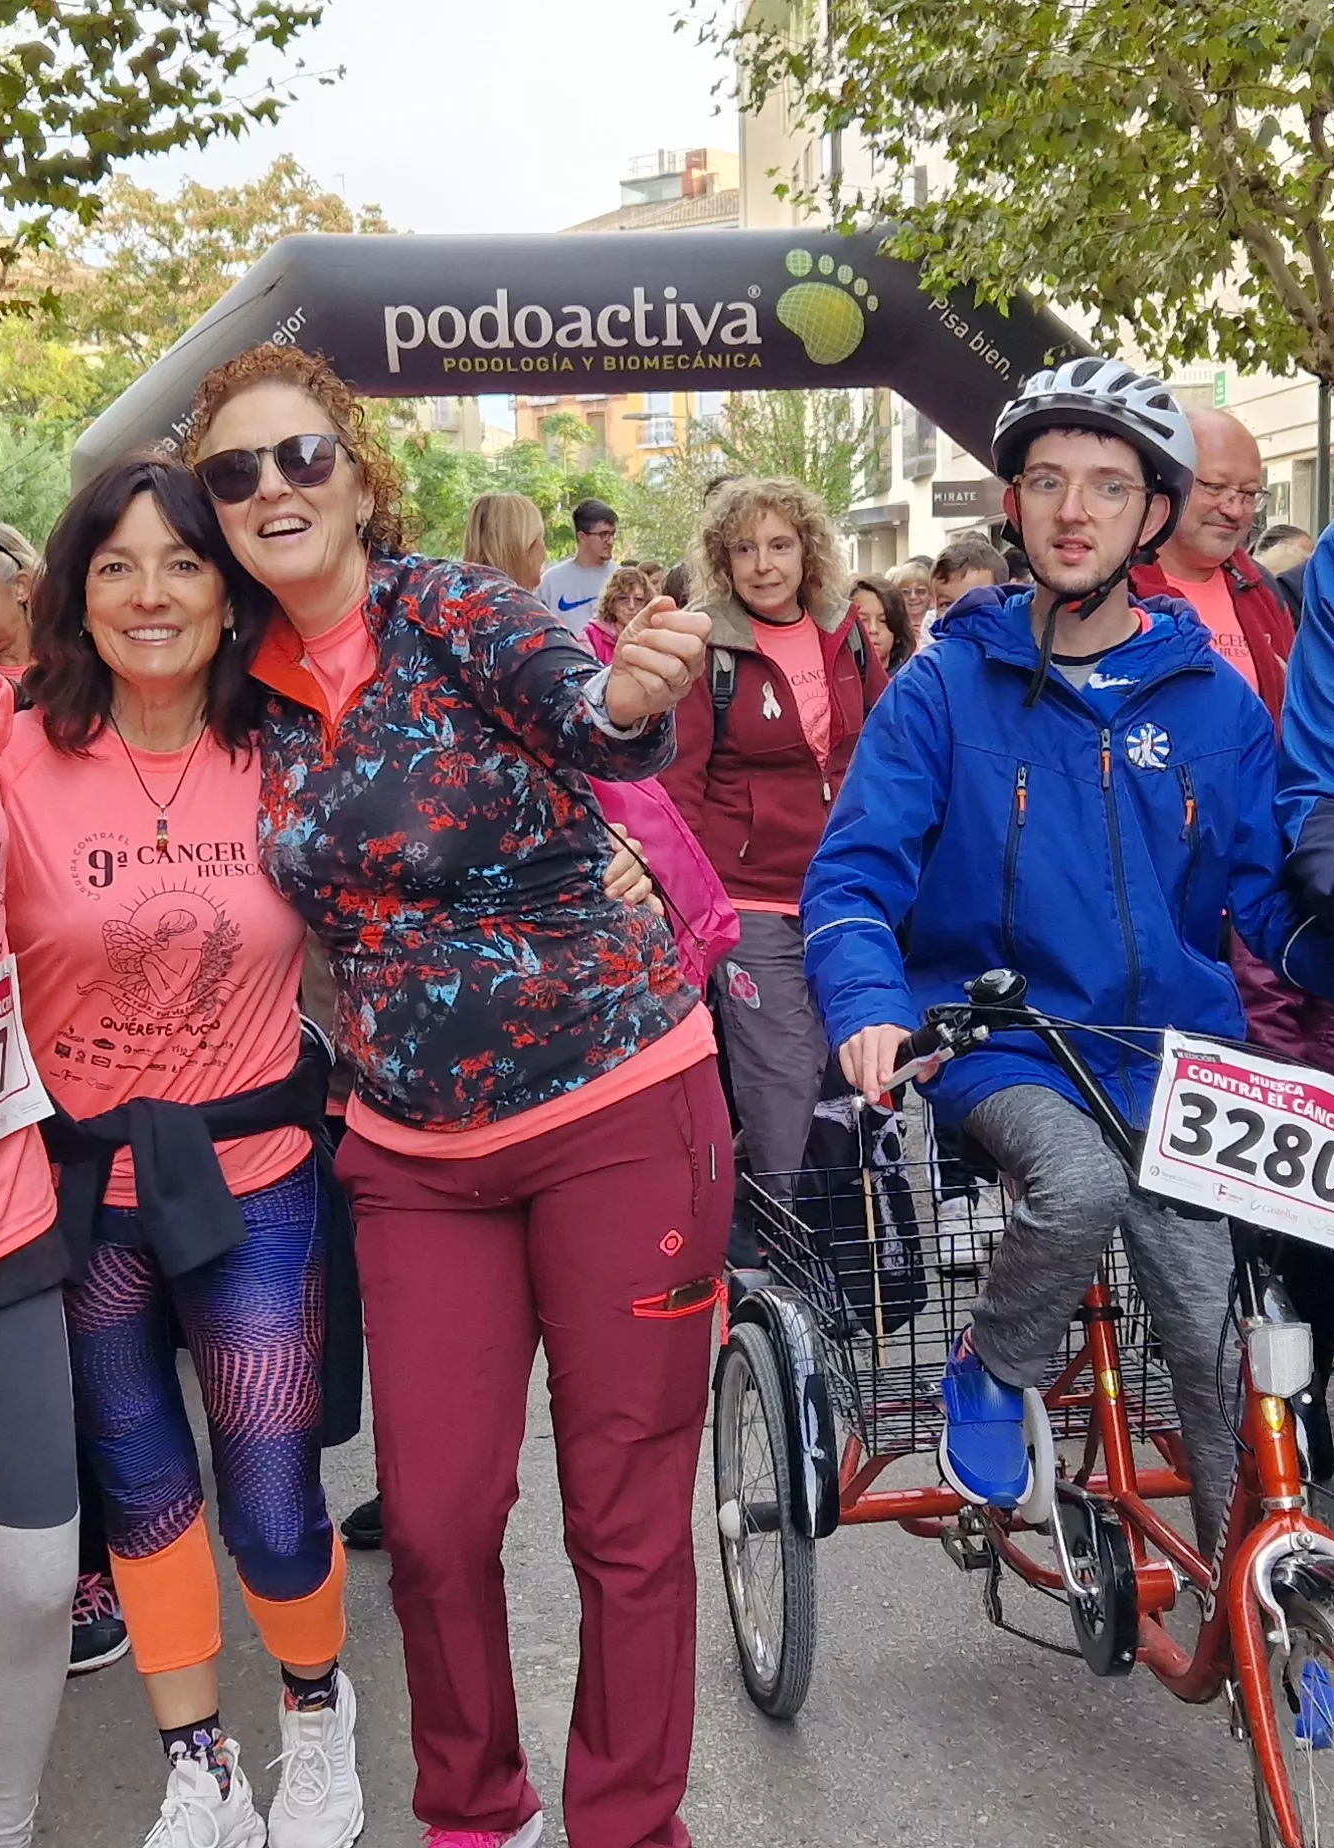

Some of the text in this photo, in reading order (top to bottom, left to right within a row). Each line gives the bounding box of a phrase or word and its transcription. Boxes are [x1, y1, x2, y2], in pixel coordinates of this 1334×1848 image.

[264, 306, 308, 349] ejor
[928, 297, 1012, 381] Pisa bien,
[443, 350, 762, 373] PODOLOGÍA Y BIOMECÁNICA
[934, 491, 977, 502] MIRATE
[790, 669, 827, 687] CÁNC
[70, 832, 131, 901] CARRERA CONTRA EL
[88, 848, 129, 888] 9ª
[197, 863, 266, 878] HUESCA
[100, 1017, 173, 1037] QUIÉRETE
[1187, 1064, 1264, 1102] CONTRA
[1267, 1091, 1288, 1110] EL
[1249, 1073, 1305, 1097] HUESCA
